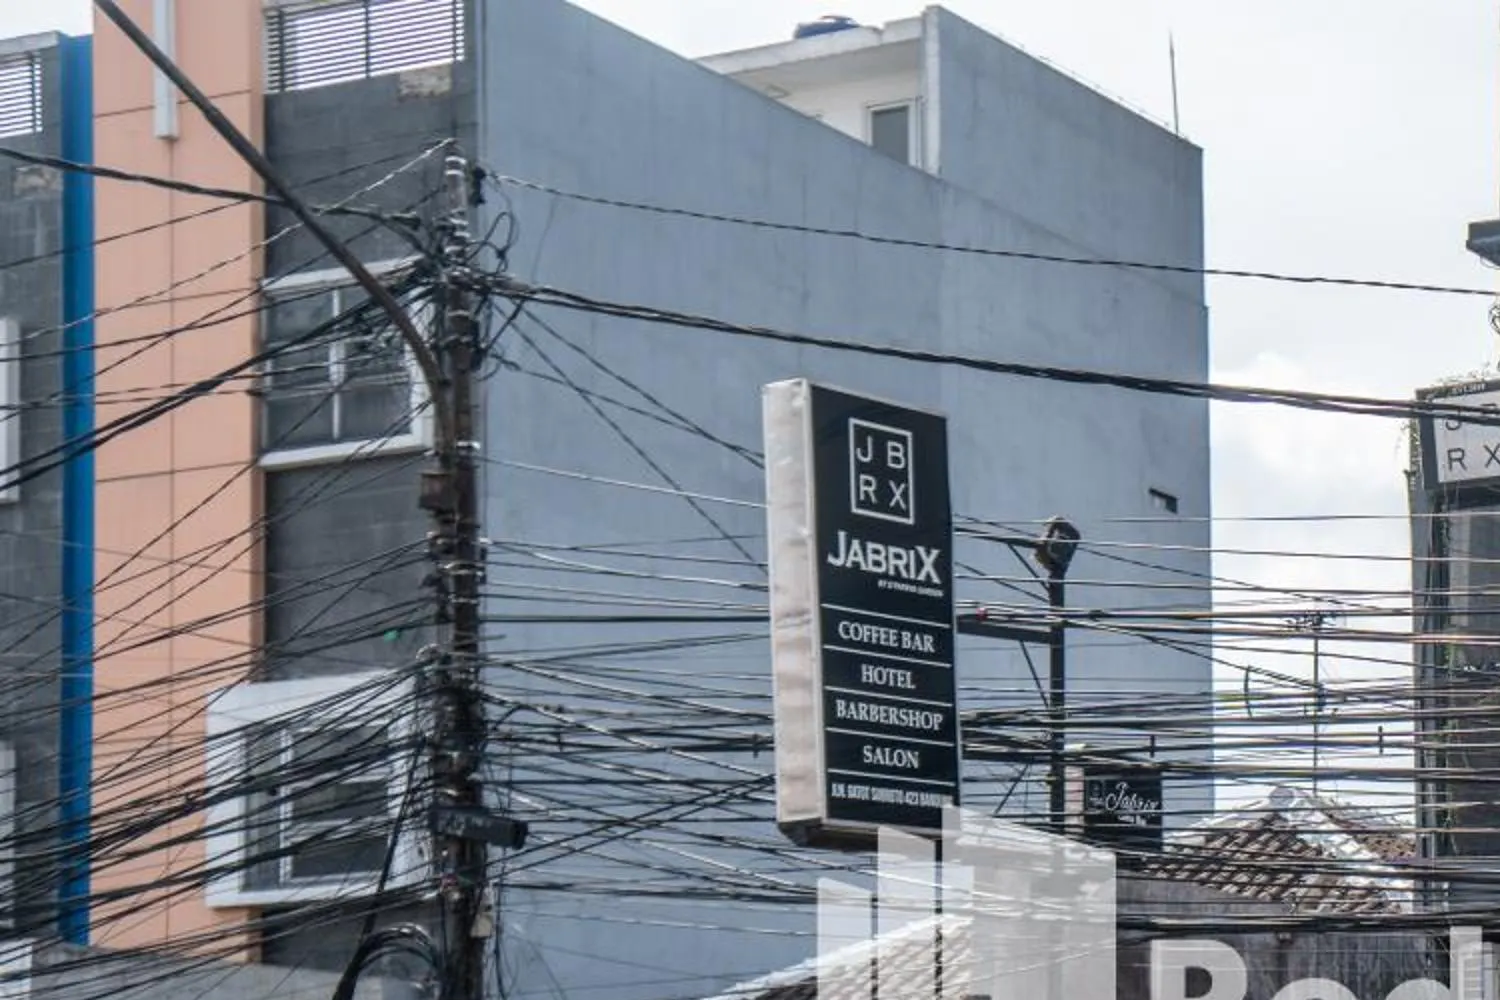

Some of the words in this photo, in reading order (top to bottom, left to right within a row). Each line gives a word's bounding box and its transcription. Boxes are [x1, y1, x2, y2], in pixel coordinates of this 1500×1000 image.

[827, 529, 942, 584] JABRIX
[838, 621, 899, 648] COFFEE
[901, 630, 935, 653] BAR
[861, 663, 916, 690] HOTEL
[836, 698, 944, 731] BARBERSHOP
[863, 745, 919, 769] SALON
